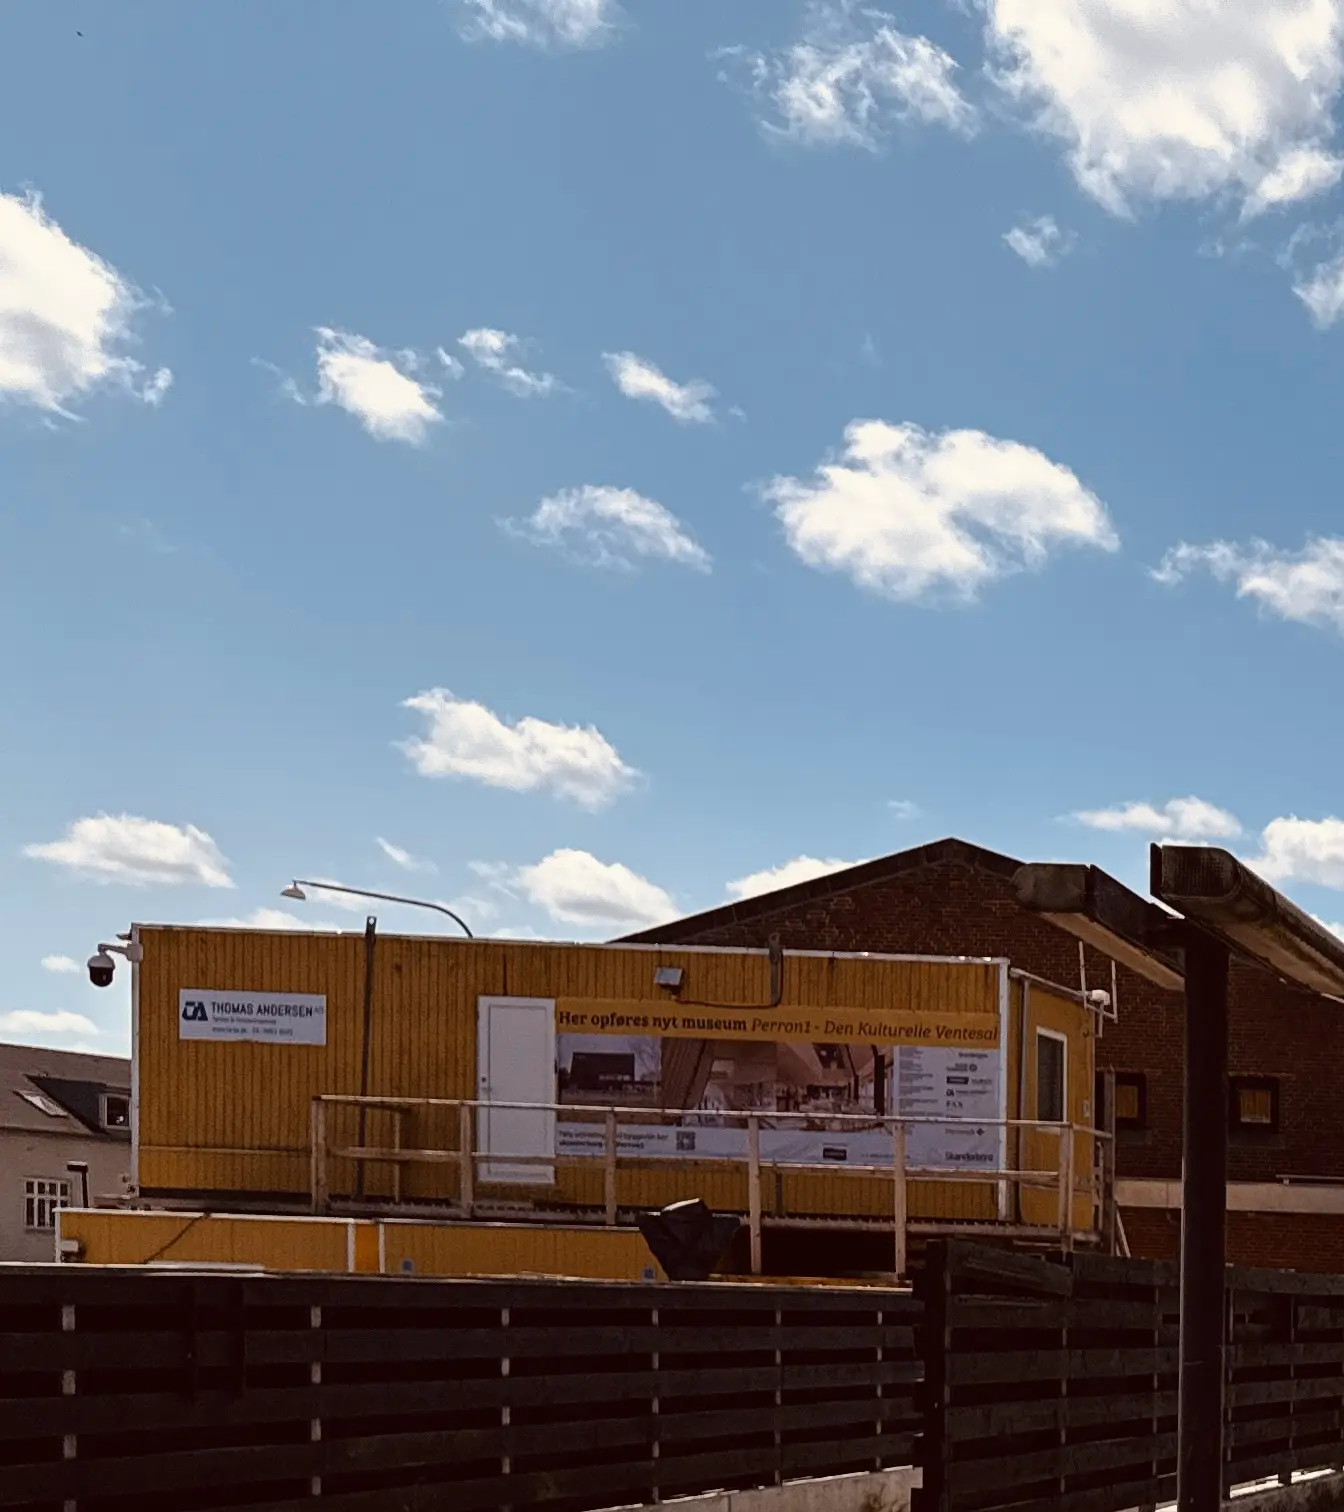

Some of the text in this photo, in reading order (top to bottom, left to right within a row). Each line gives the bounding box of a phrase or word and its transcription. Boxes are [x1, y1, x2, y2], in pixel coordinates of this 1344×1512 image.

[211, 1002, 254, 1015] THOMAS
[256, 1004, 313, 1017] ANDERSEN
[559, 1011, 588, 1026] Her
[591, 1012, 649, 1032] opføres
[653, 1015, 678, 1031] nyt
[682, 1018, 747, 1032] museum
[751, 1018, 811, 1034] Perron1
[825, 1020, 853, 1036] Den
[857, 1022, 931, 1038] Kulturelle
[936, 1025, 998, 1041] Ventesal
